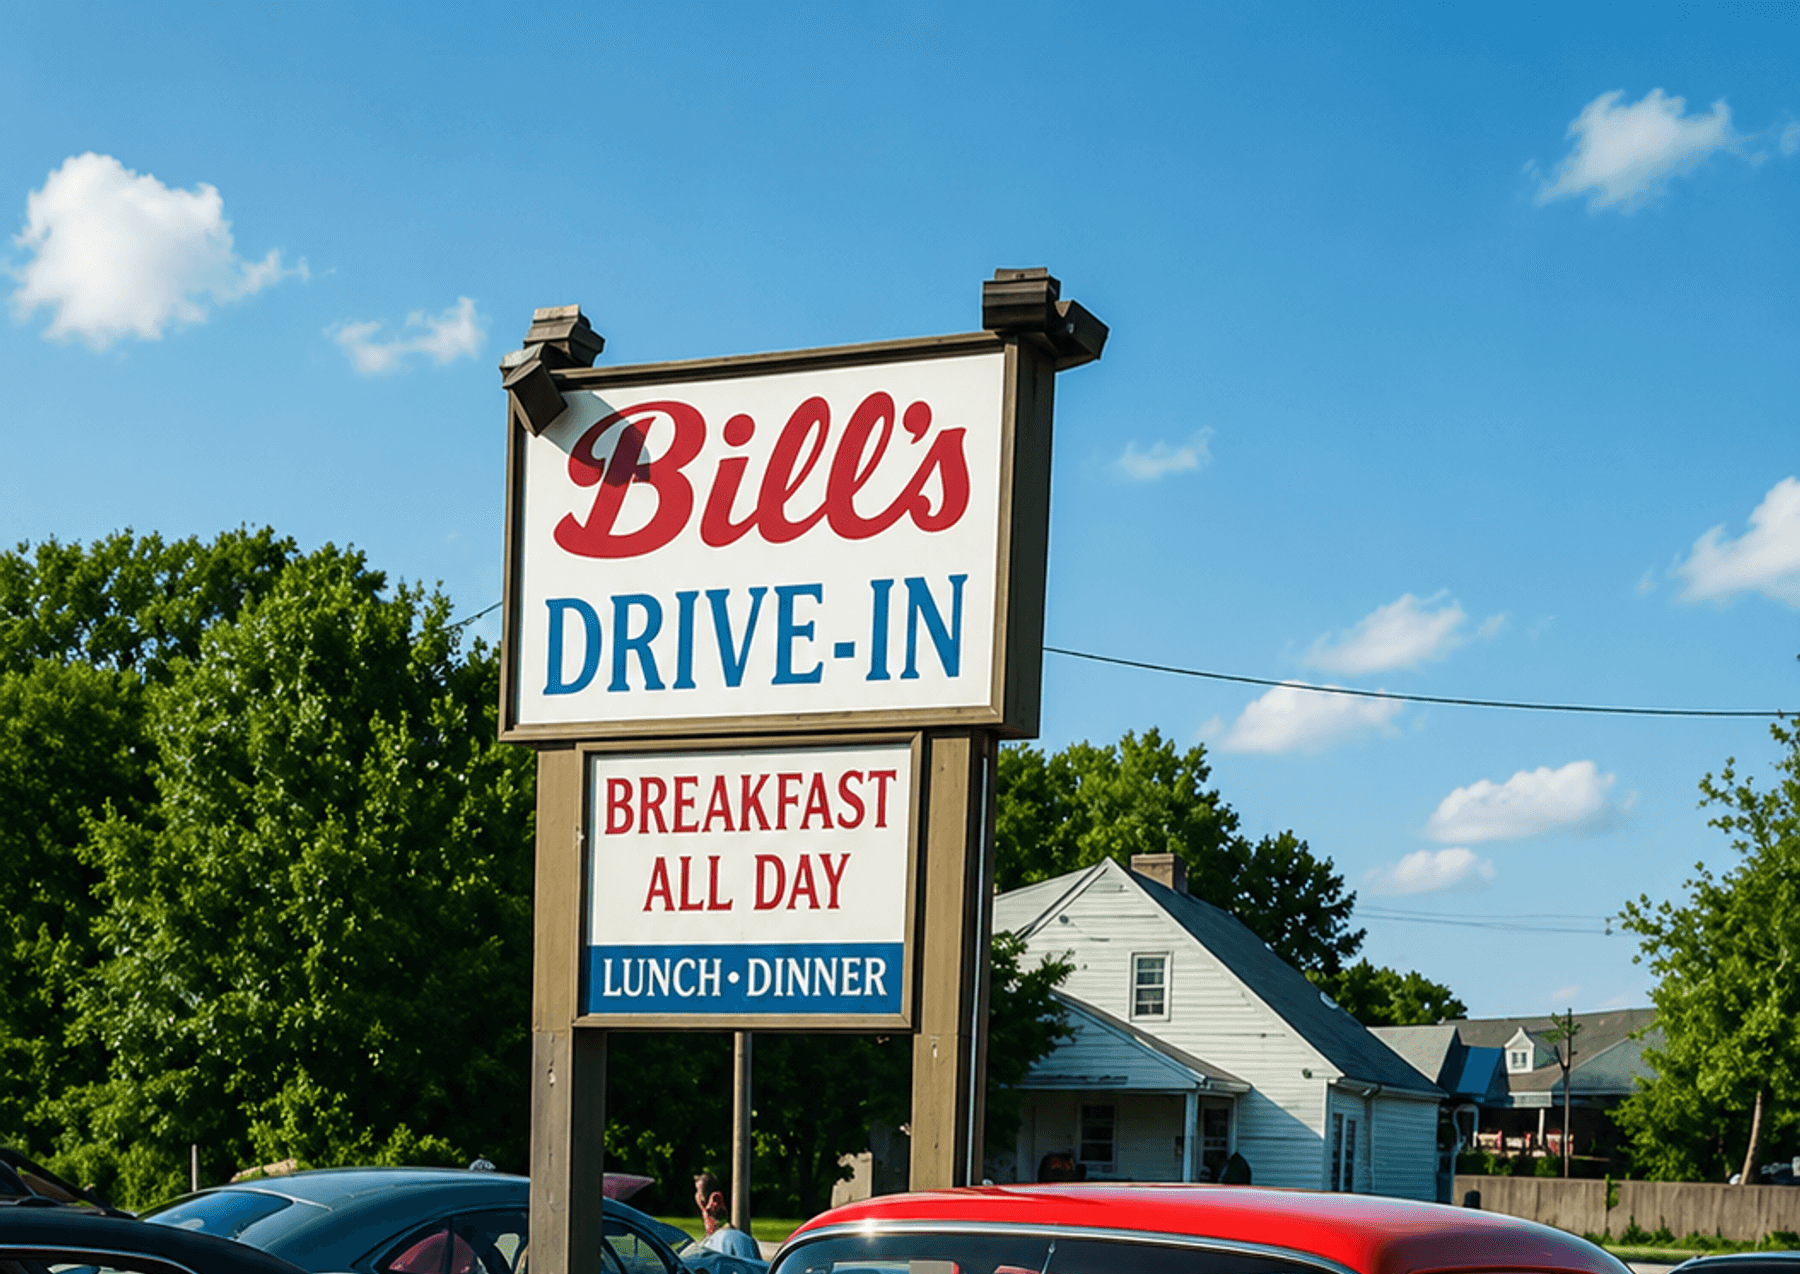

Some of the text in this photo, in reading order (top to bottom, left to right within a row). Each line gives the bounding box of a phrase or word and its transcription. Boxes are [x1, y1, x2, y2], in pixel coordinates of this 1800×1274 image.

[553, 391, 970, 559] Bill's
[543, 574, 967, 695] DRIVE-IN
[605, 770, 896, 835] BREAKFAST
[644, 853, 850, 911] ALL DAY
[603, 957, 888, 997] LUNCH DINNER
